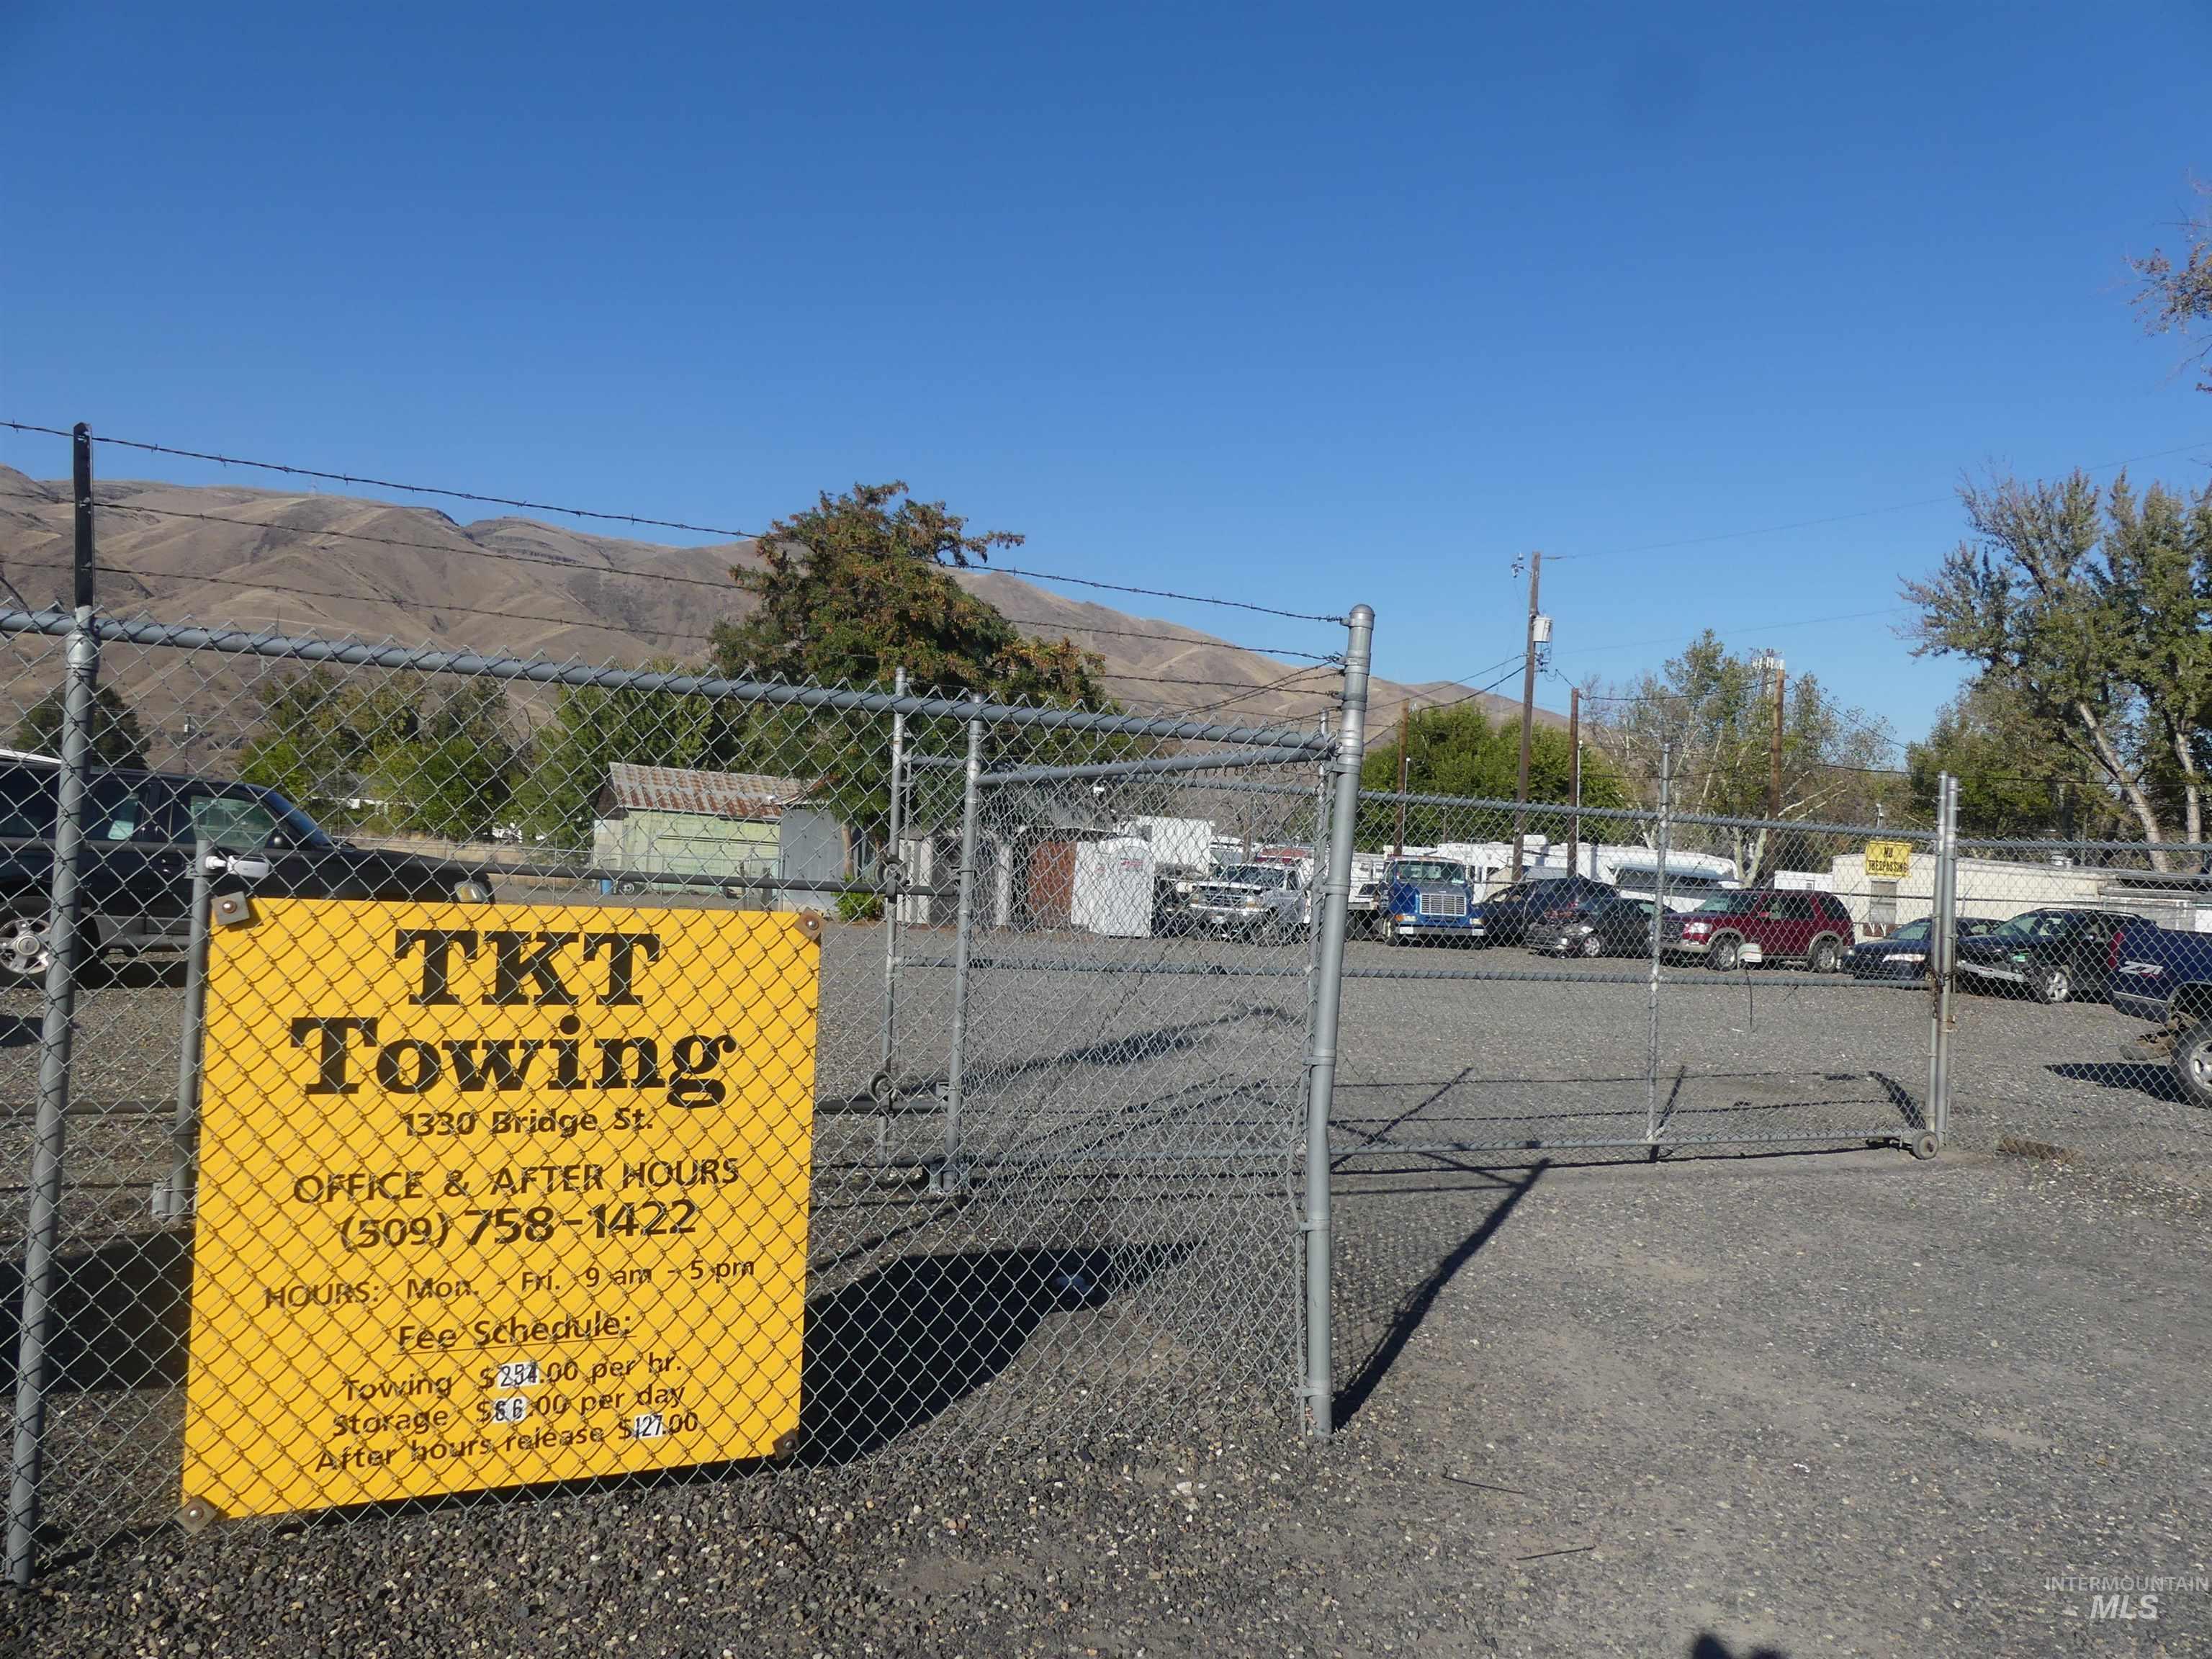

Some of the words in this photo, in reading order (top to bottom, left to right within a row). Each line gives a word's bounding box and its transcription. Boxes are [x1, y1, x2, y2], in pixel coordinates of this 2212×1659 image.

[1868, 860, 1908, 873] TRESPASSING
[395, 929, 660, 1005] TKT
[290, 1014, 737, 1109] Towing
[403, 1111, 477, 1137] 1330
[491, 1108, 598, 1139] Bridge
[613, 1106, 655, 1130] St.
[293, 1169, 424, 1203] OFFICE
[443, 1169, 470, 1197] &
[490, 1164, 604, 1195] AFTER
[622, 1157, 739, 1190] HOURS
[265, 1281, 379, 1309] HOURS:
[406, 1277, 480, 1300] Mon.
[521, 1269, 561, 1292] Fri.
[585, 1266, 601, 1288] 9
[613, 1267, 652, 1286] am
[691, 1260, 704, 1280] 5
[714, 1260, 755, 1284] pm
[399, 1325, 457, 1350] Fee
[474, 1310, 631, 1346] Schedule:
[343, 1372, 452, 1401] Towing
[591, 1359, 636, 1383] per
[649, 1352, 683, 1373] hr.
[333, 1409, 449, 1437] Storage
[581, 1391, 626, 1416] per
[639, 1384, 685, 1408] day
[315, 1446, 396, 1473] After
[411, 1439, 493, 1462] hours
[505, 1426, 605, 1453] release
